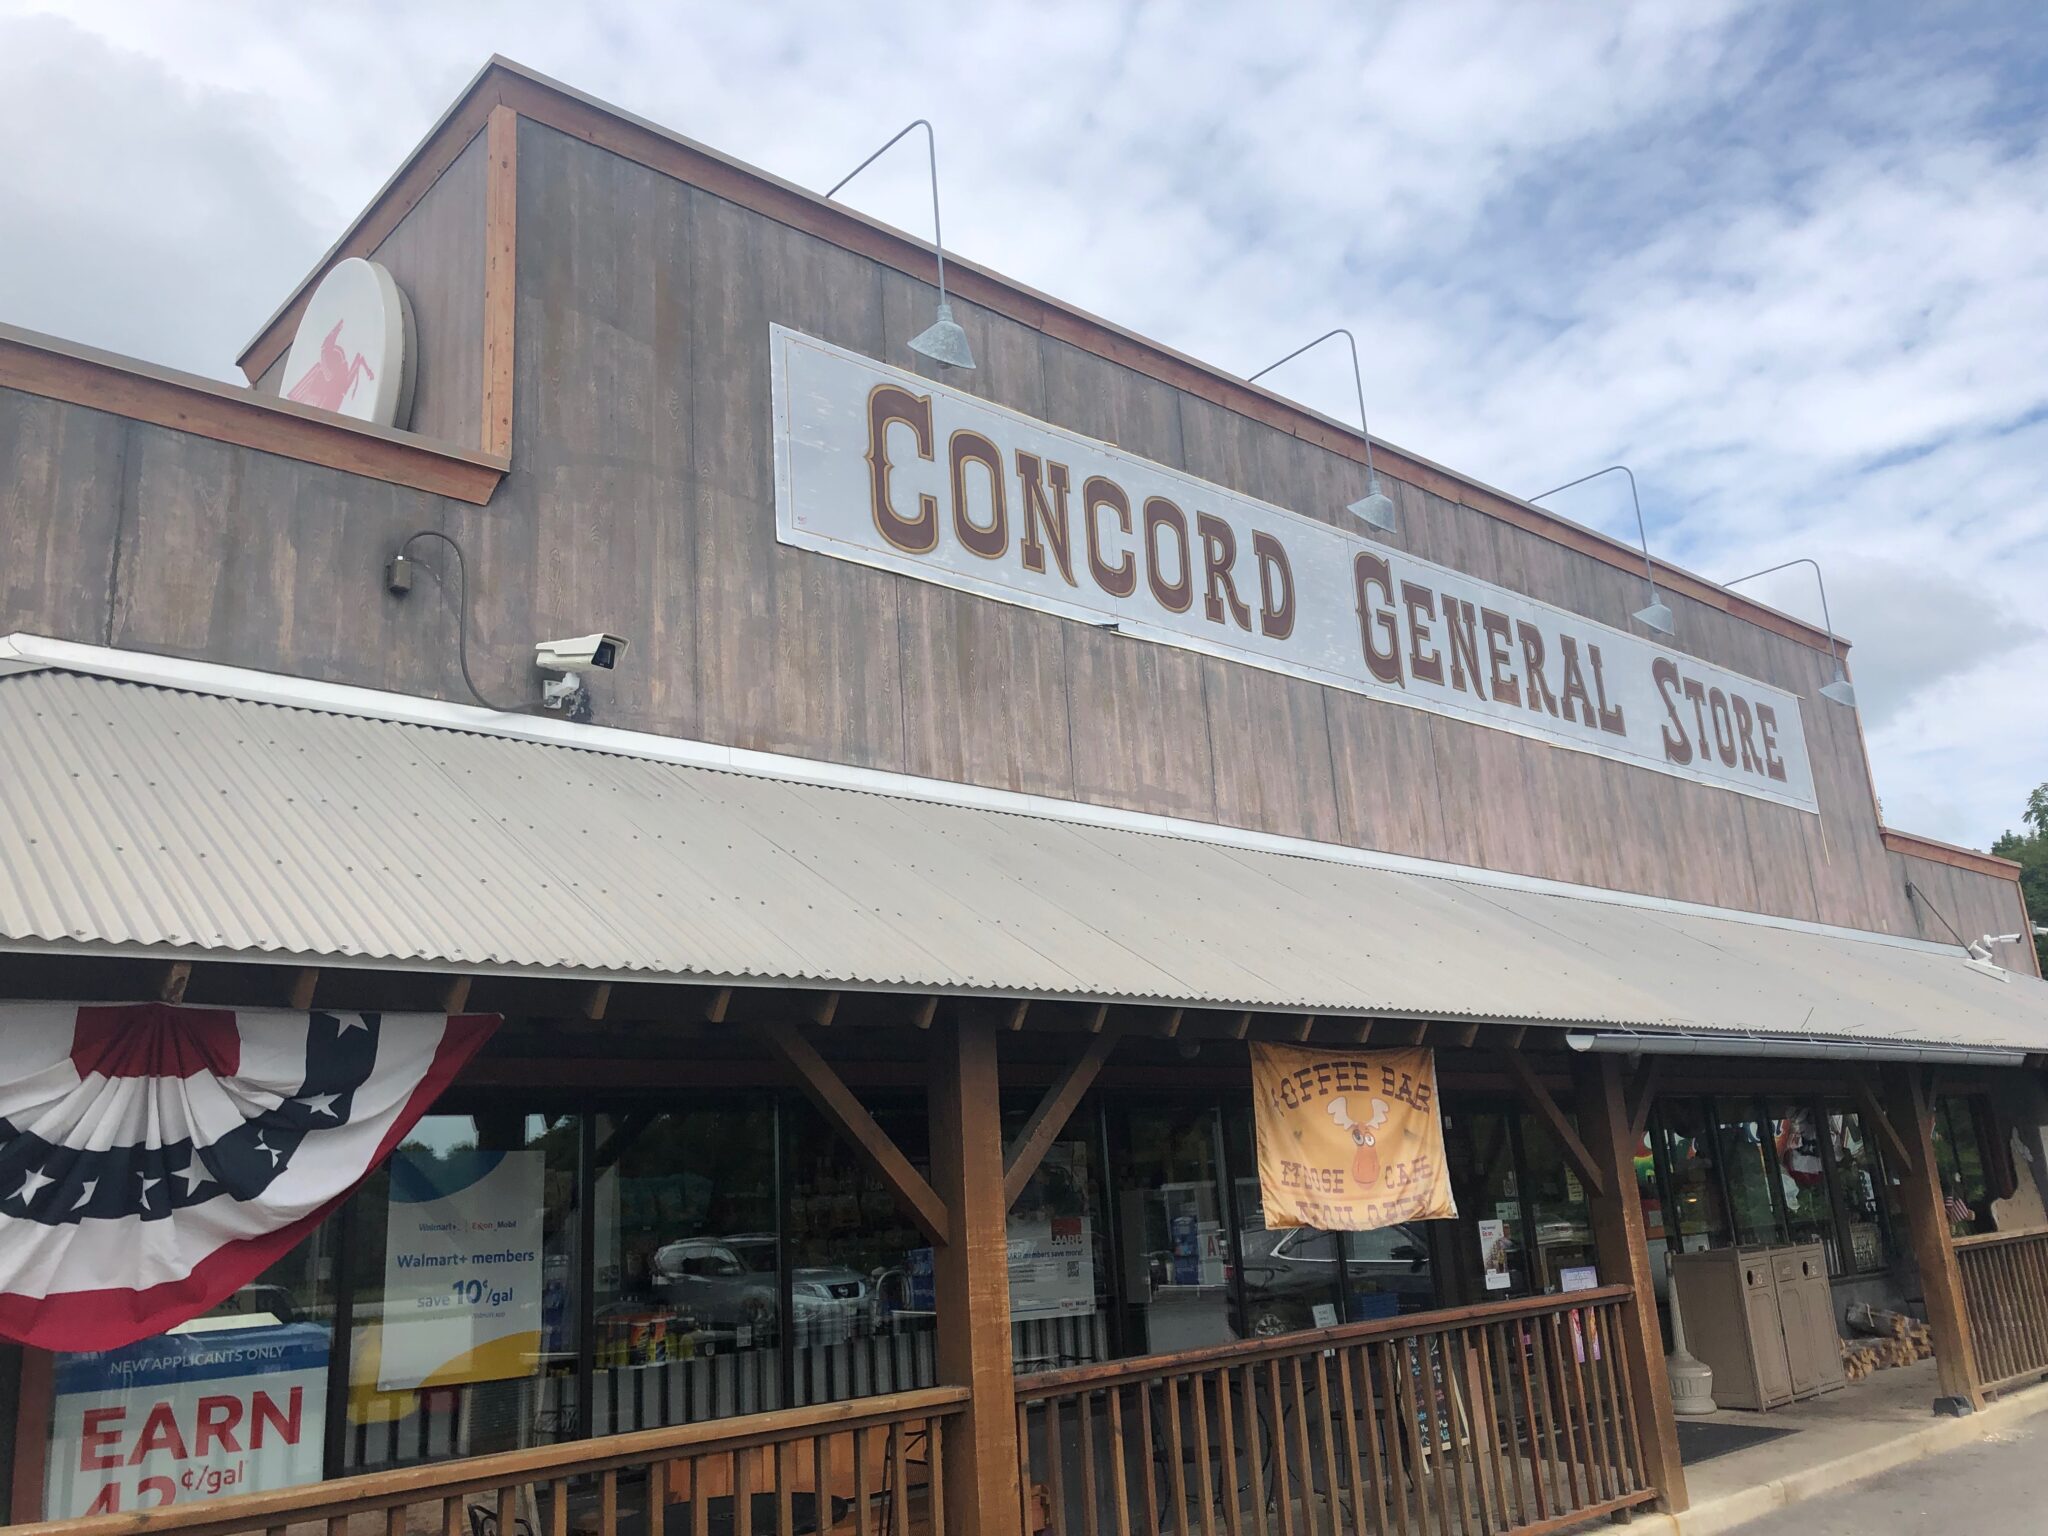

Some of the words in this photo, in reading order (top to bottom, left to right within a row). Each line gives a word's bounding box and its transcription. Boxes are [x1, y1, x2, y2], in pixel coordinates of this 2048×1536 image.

[863, 383, 1296, 641] CONCORD
[1354, 551, 1626, 737] GENERAL
[1651, 657, 1788, 783] STORE
[1381, 1066, 1432, 1114] BAR
[1281, 1160, 1345, 1194] MOOSE
[397, 1253, 468, 1269] Walmart+
[471, 1249, 535, 1264] members
[417, 1296, 450, 1309] save
[110, 1358, 150, 1374] NEW
[151, 1349, 243, 1370] APPLICANTS
[245, 1345, 286, 1360] ONLY
[80, 1386, 304, 1472] EARN
